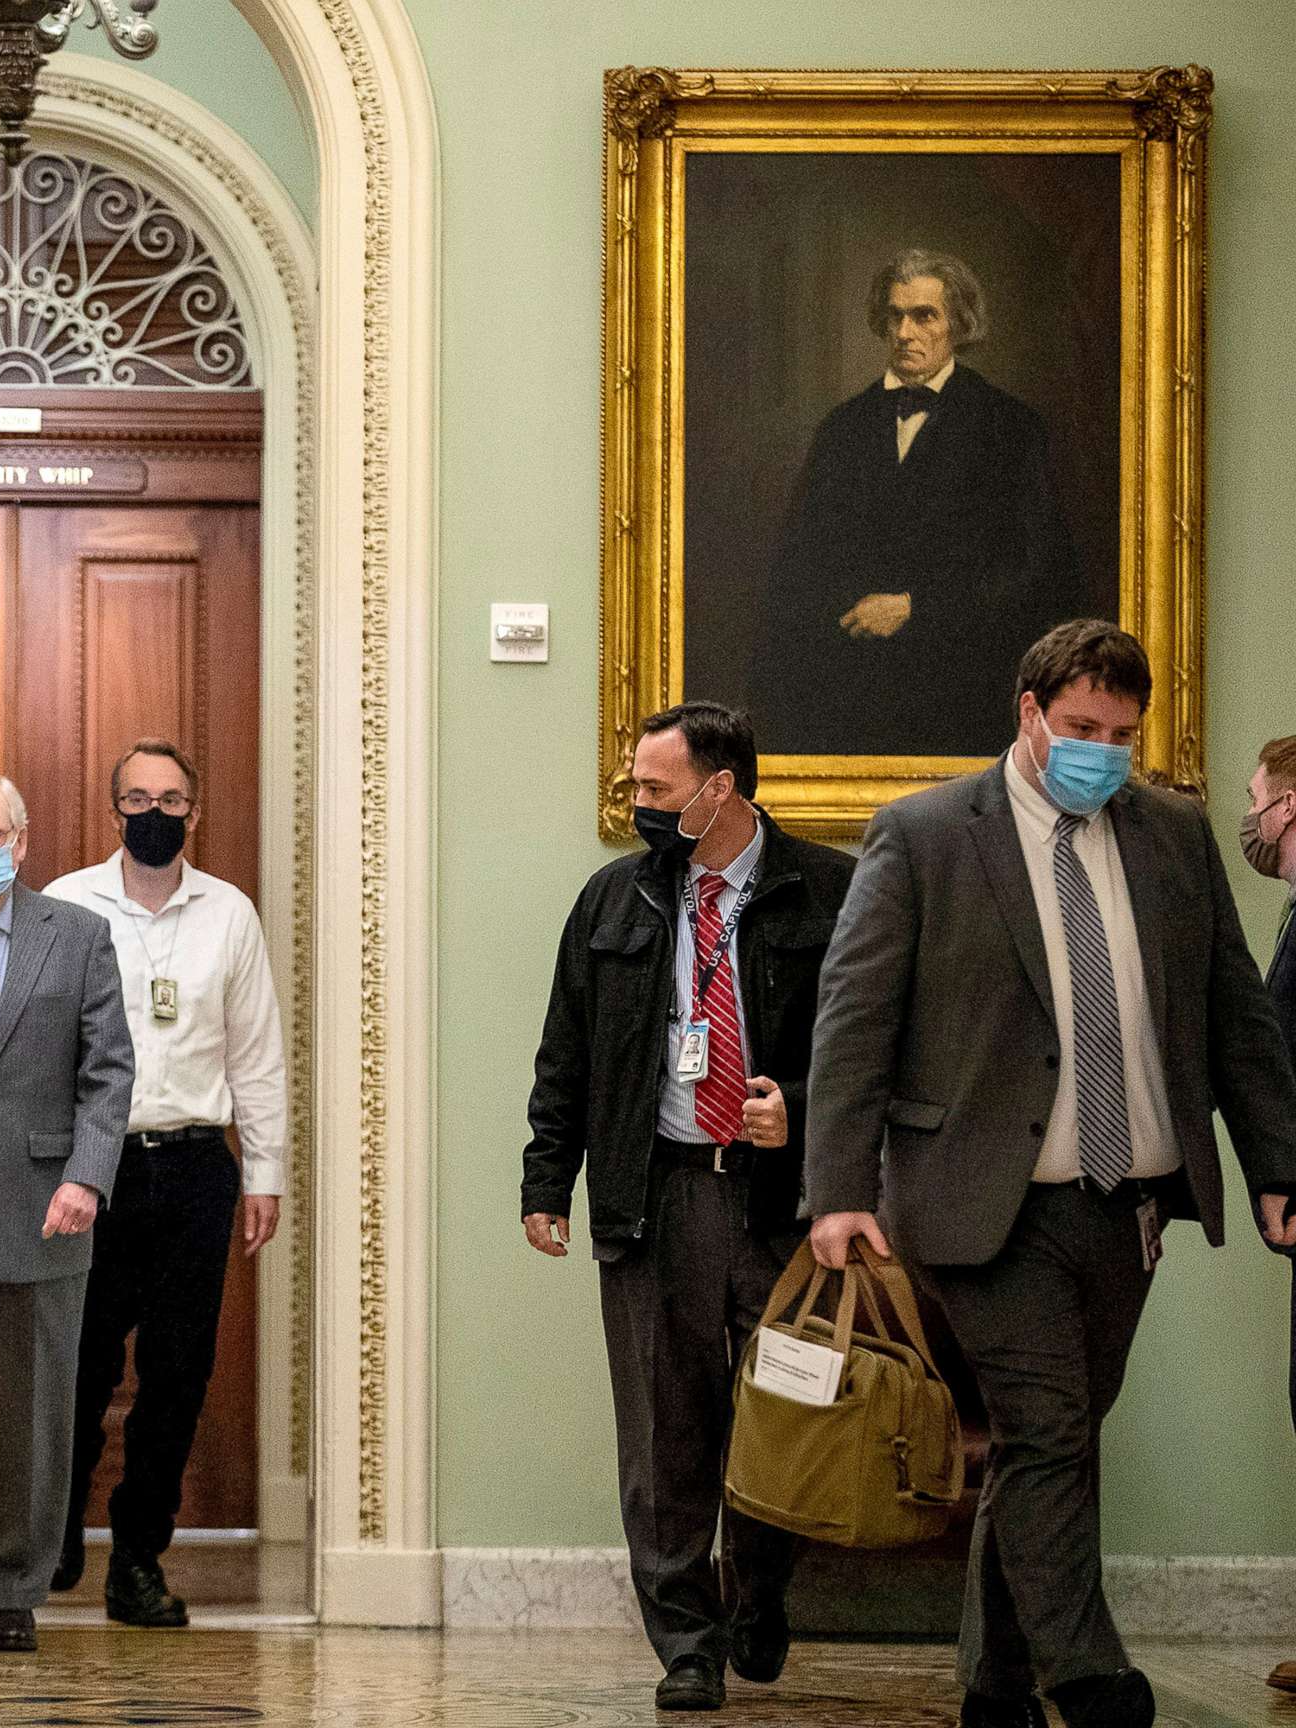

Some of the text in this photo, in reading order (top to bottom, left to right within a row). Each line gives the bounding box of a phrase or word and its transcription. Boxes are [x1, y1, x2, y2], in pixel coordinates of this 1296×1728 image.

[39, 467, 94, 485] WHIP
[708, 949, 722, 967] US
[719, 890, 751, 942] CAPITOL
